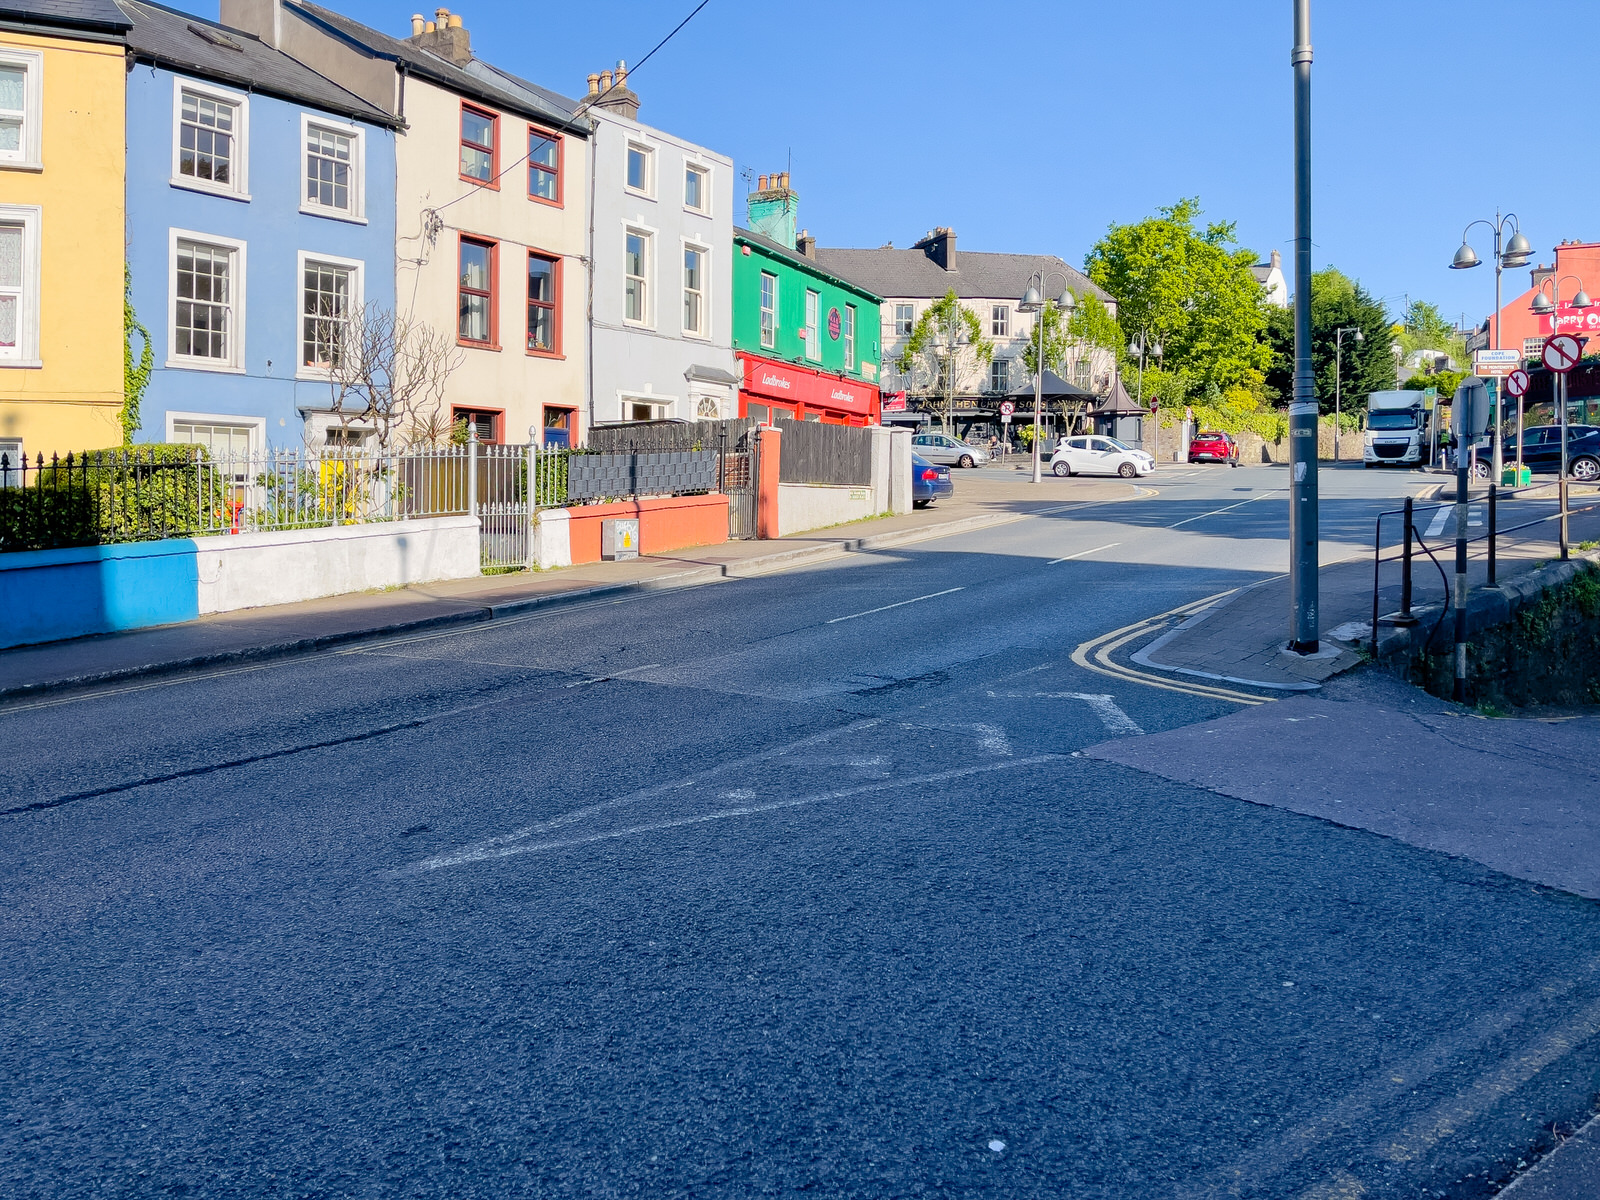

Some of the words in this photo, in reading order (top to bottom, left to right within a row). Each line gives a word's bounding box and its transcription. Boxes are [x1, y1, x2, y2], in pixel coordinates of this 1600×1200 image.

[762, 373, 790, 389] Ladbrokes
[831, 389, 854, 403] Ladbrokes
[956, 400, 1000, 408] HENCHY
